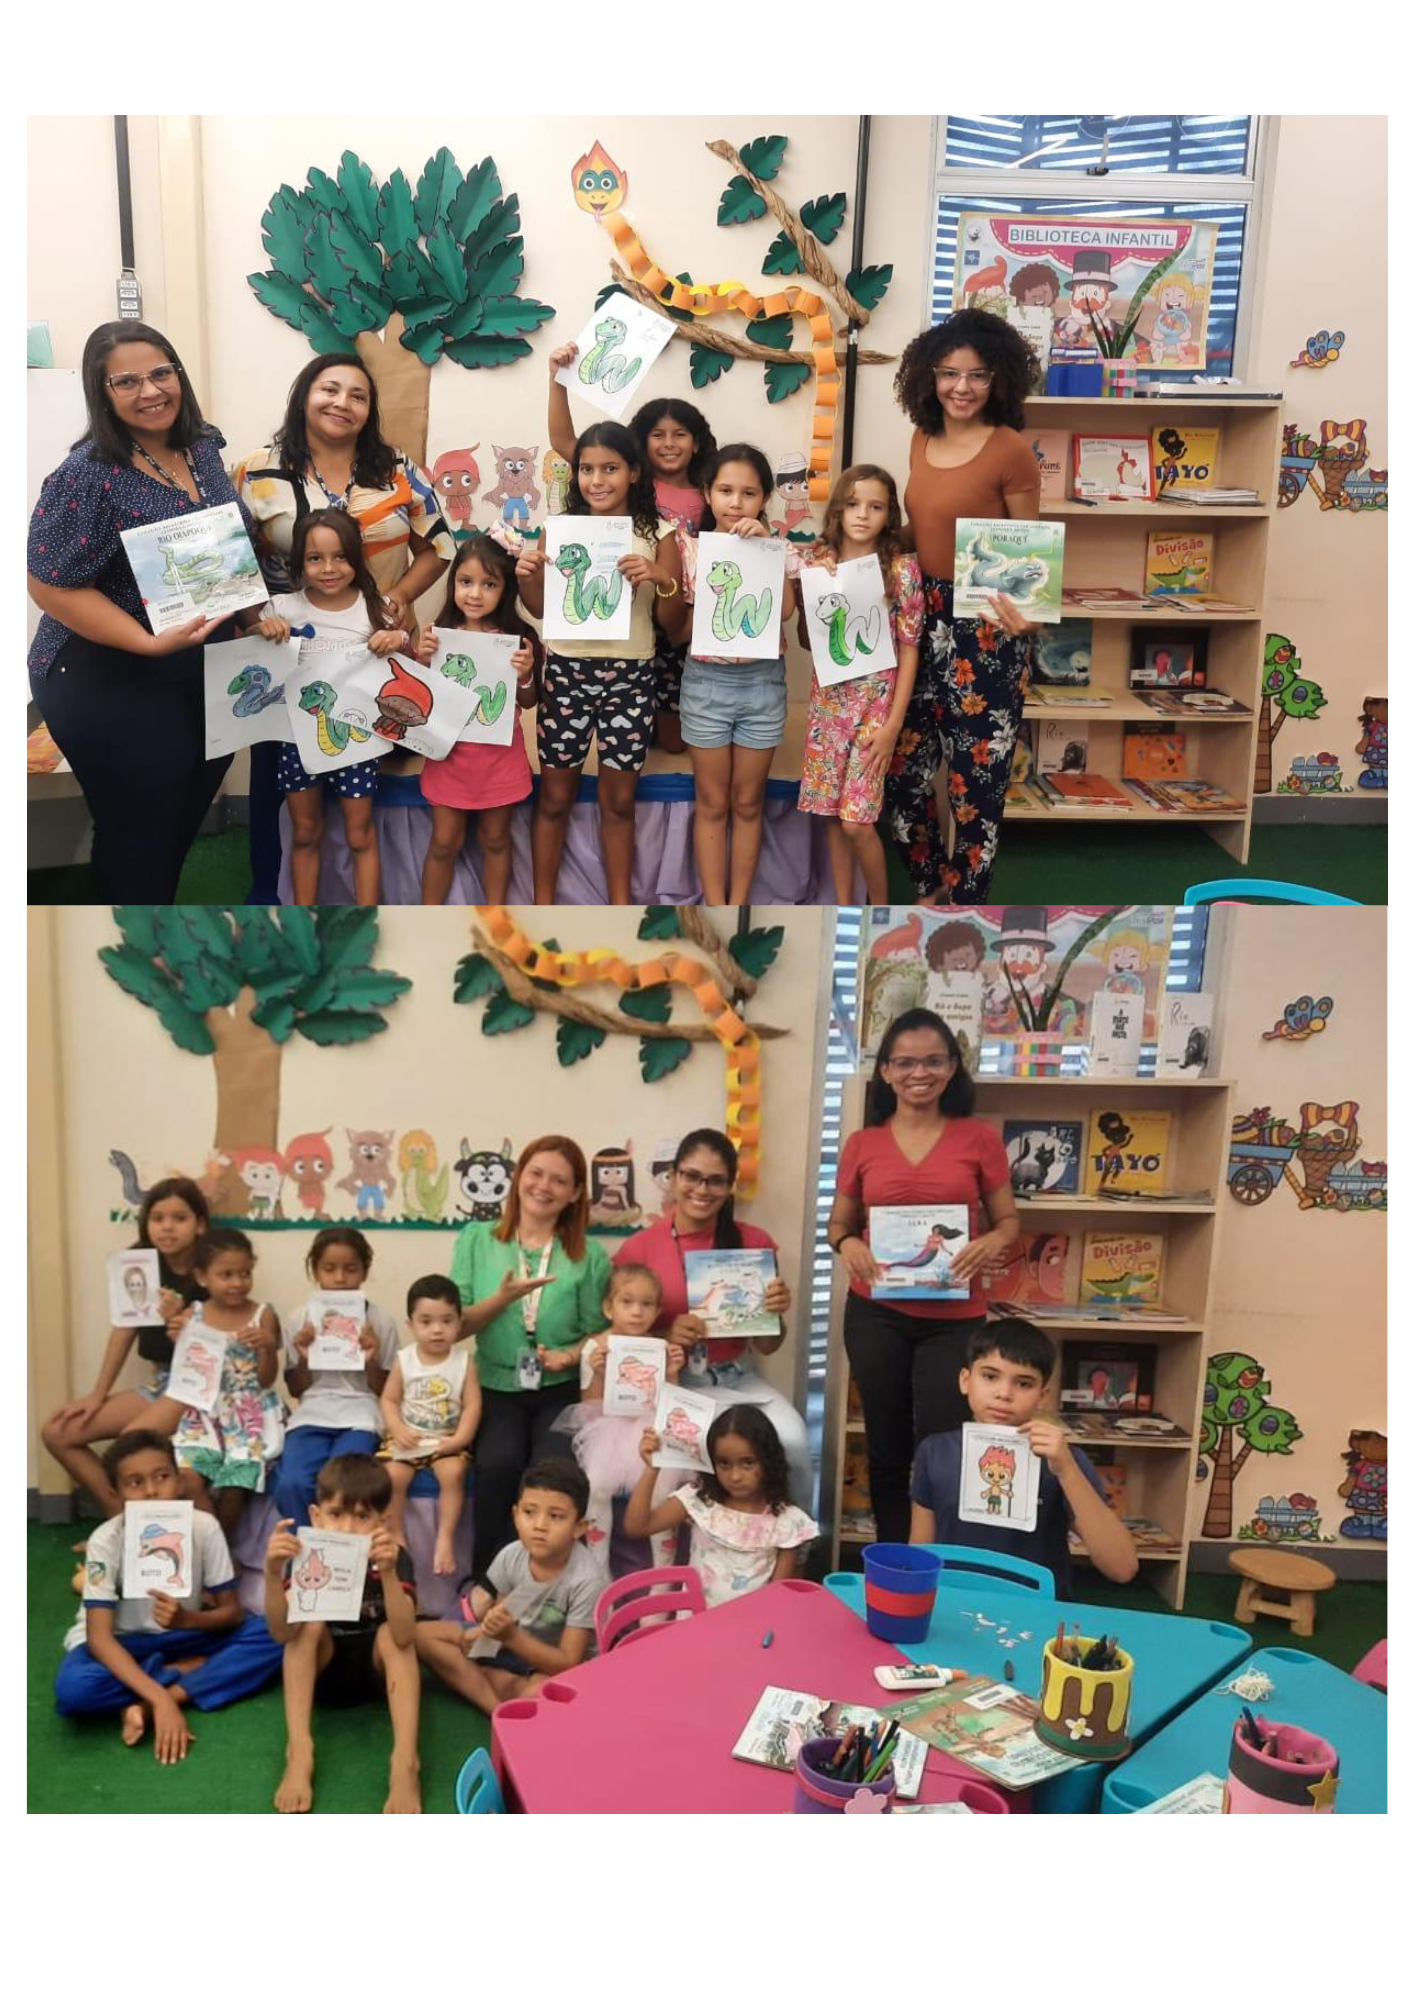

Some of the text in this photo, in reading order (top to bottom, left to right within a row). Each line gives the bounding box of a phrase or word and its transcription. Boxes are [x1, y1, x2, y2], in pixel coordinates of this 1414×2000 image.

[1009, 227, 1175, 247] BIBLIOTECA INFANTIL
[1155, 538, 1205, 556] Divisão
[1092, 1240, 1152, 1260] Divisão
